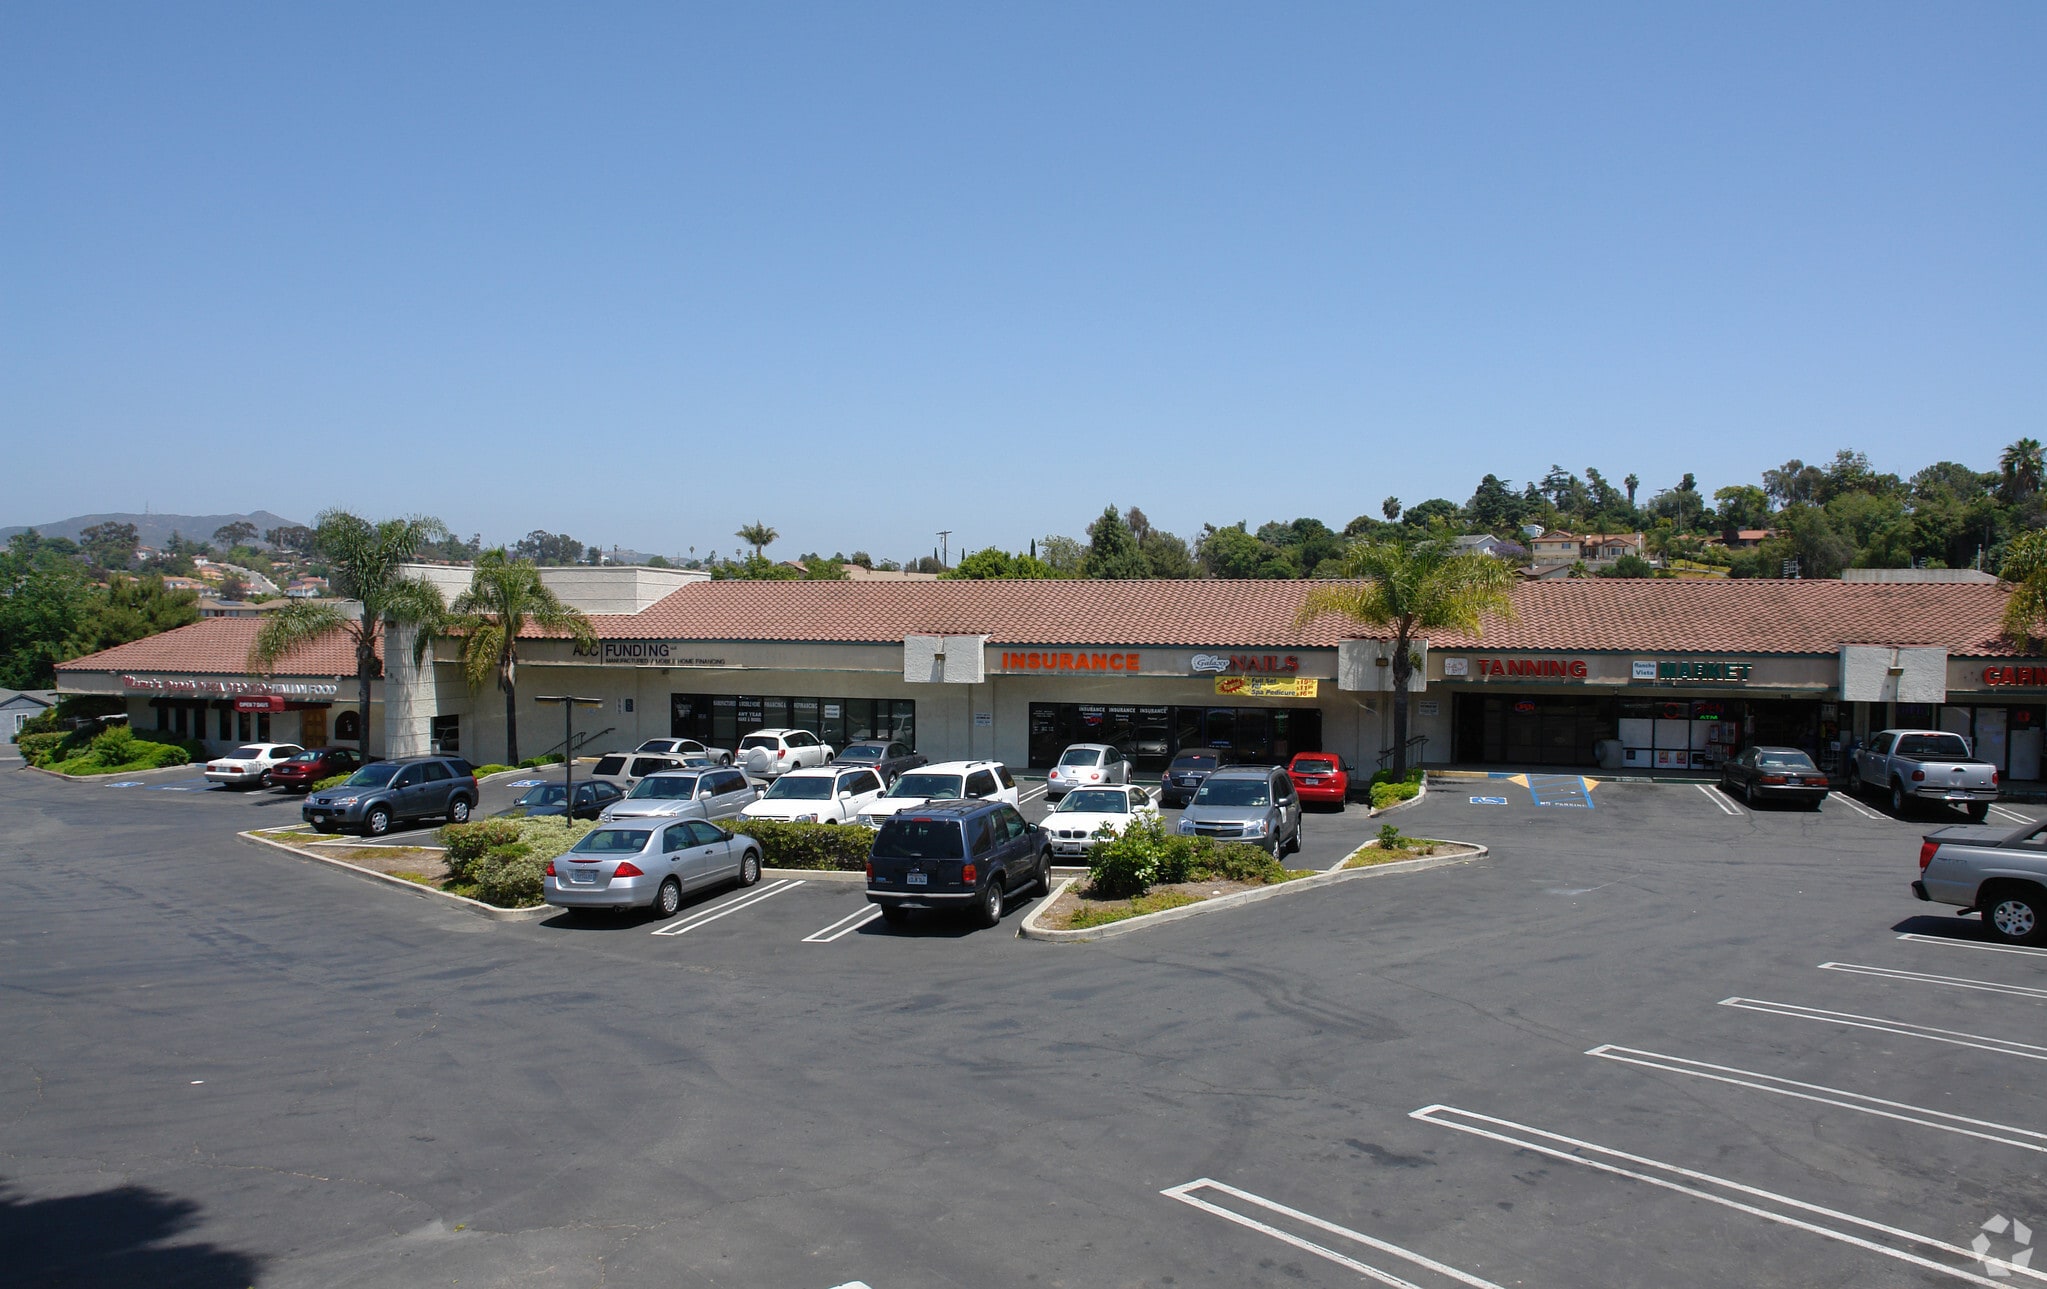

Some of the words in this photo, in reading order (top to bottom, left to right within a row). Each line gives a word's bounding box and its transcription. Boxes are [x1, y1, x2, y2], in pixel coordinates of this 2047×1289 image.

[605, 642, 669, 657] FUNDING
[1002, 652, 1140, 670] INSURANCE
[1230, 655, 1300, 672] NAILS
[1478, 659, 1588, 679] TANNING
[1660, 661, 1753, 681] MARKET
[271, 683, 307, 694] ITALIAN
[308, 684, 338, 695] FOOD
[1251, 689, 1264, 697] Spa
